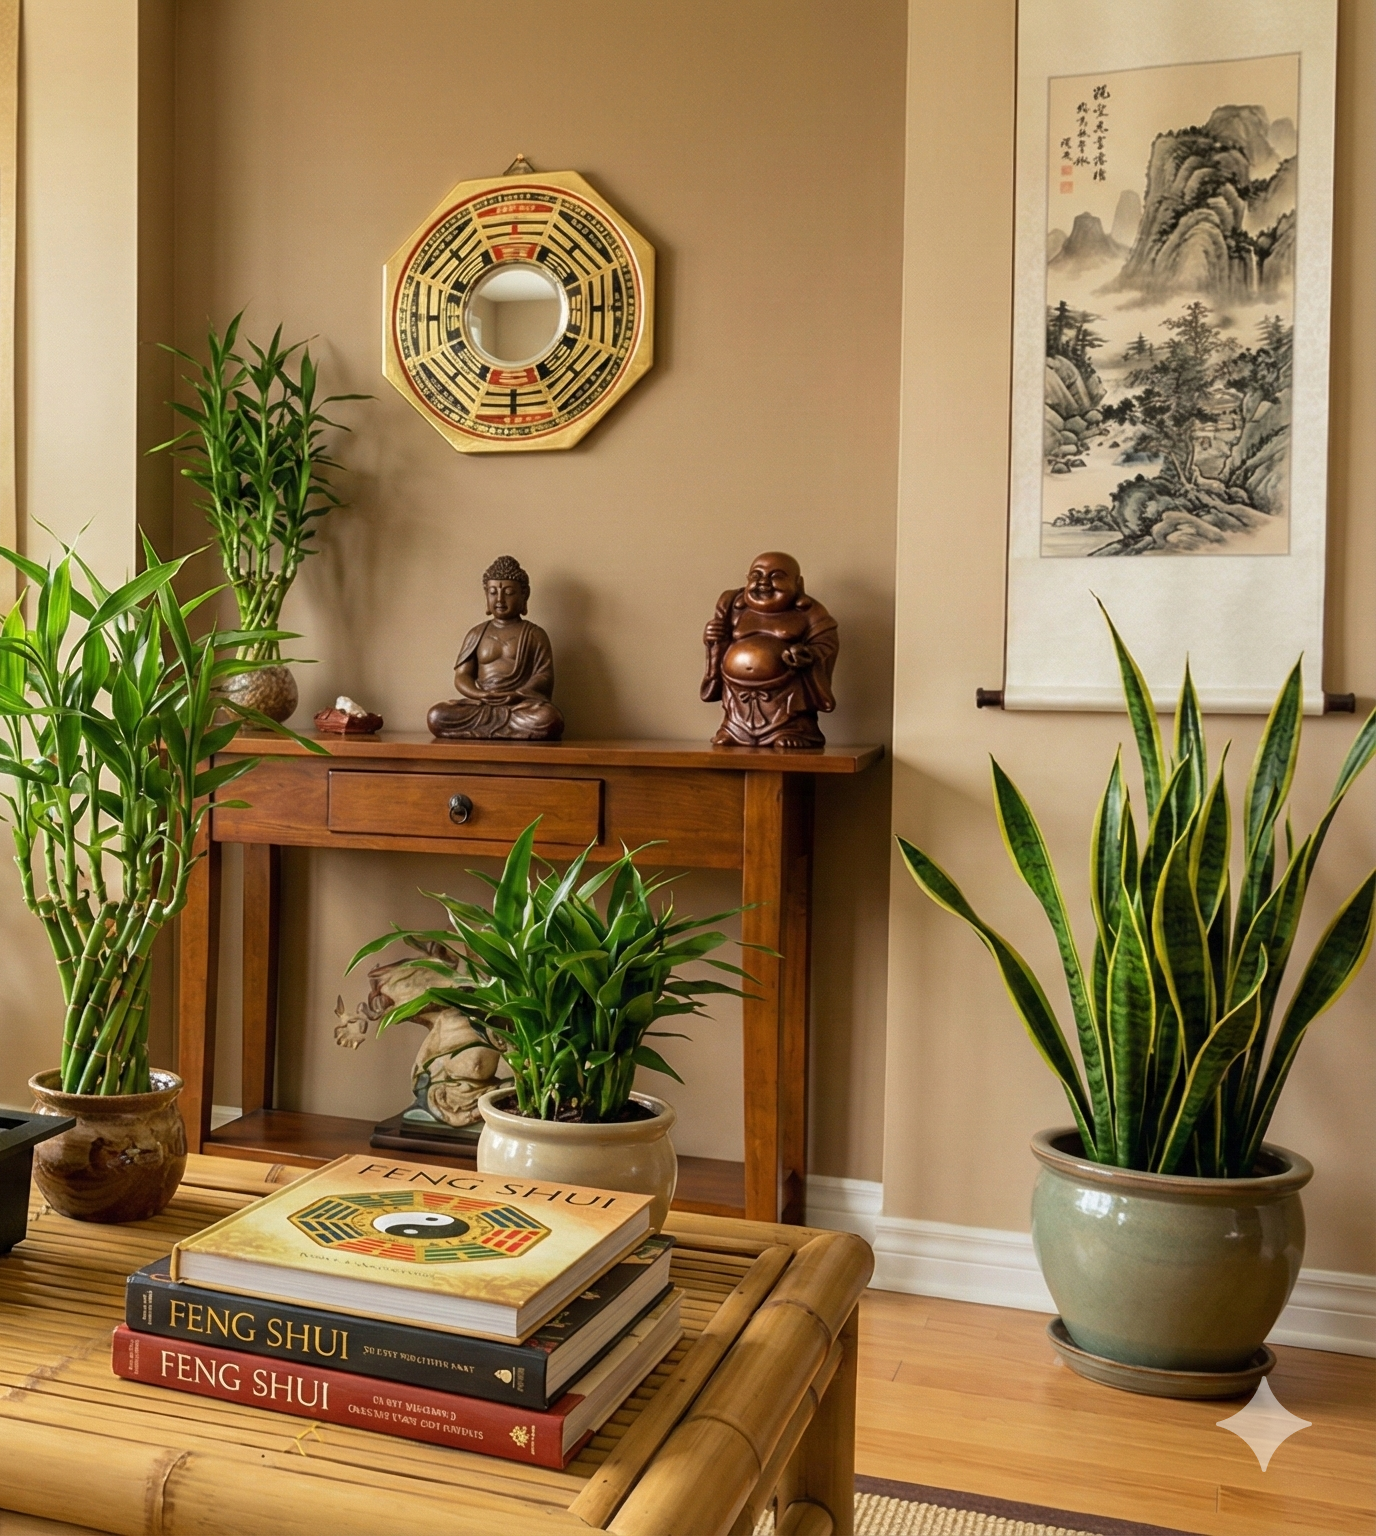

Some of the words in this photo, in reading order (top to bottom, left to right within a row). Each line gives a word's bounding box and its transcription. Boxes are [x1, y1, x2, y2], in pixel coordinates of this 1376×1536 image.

[358, 1163, 484, 1191] FENG
[496, 1183, 616, 1210] SHUI
[169, 1299, 256, 1342] FENG
[266, 1318, 349, 1360] SHUI
[161, 1350, 241, 1391] FENG
[252, 1368, 329, 1411] SHUI
